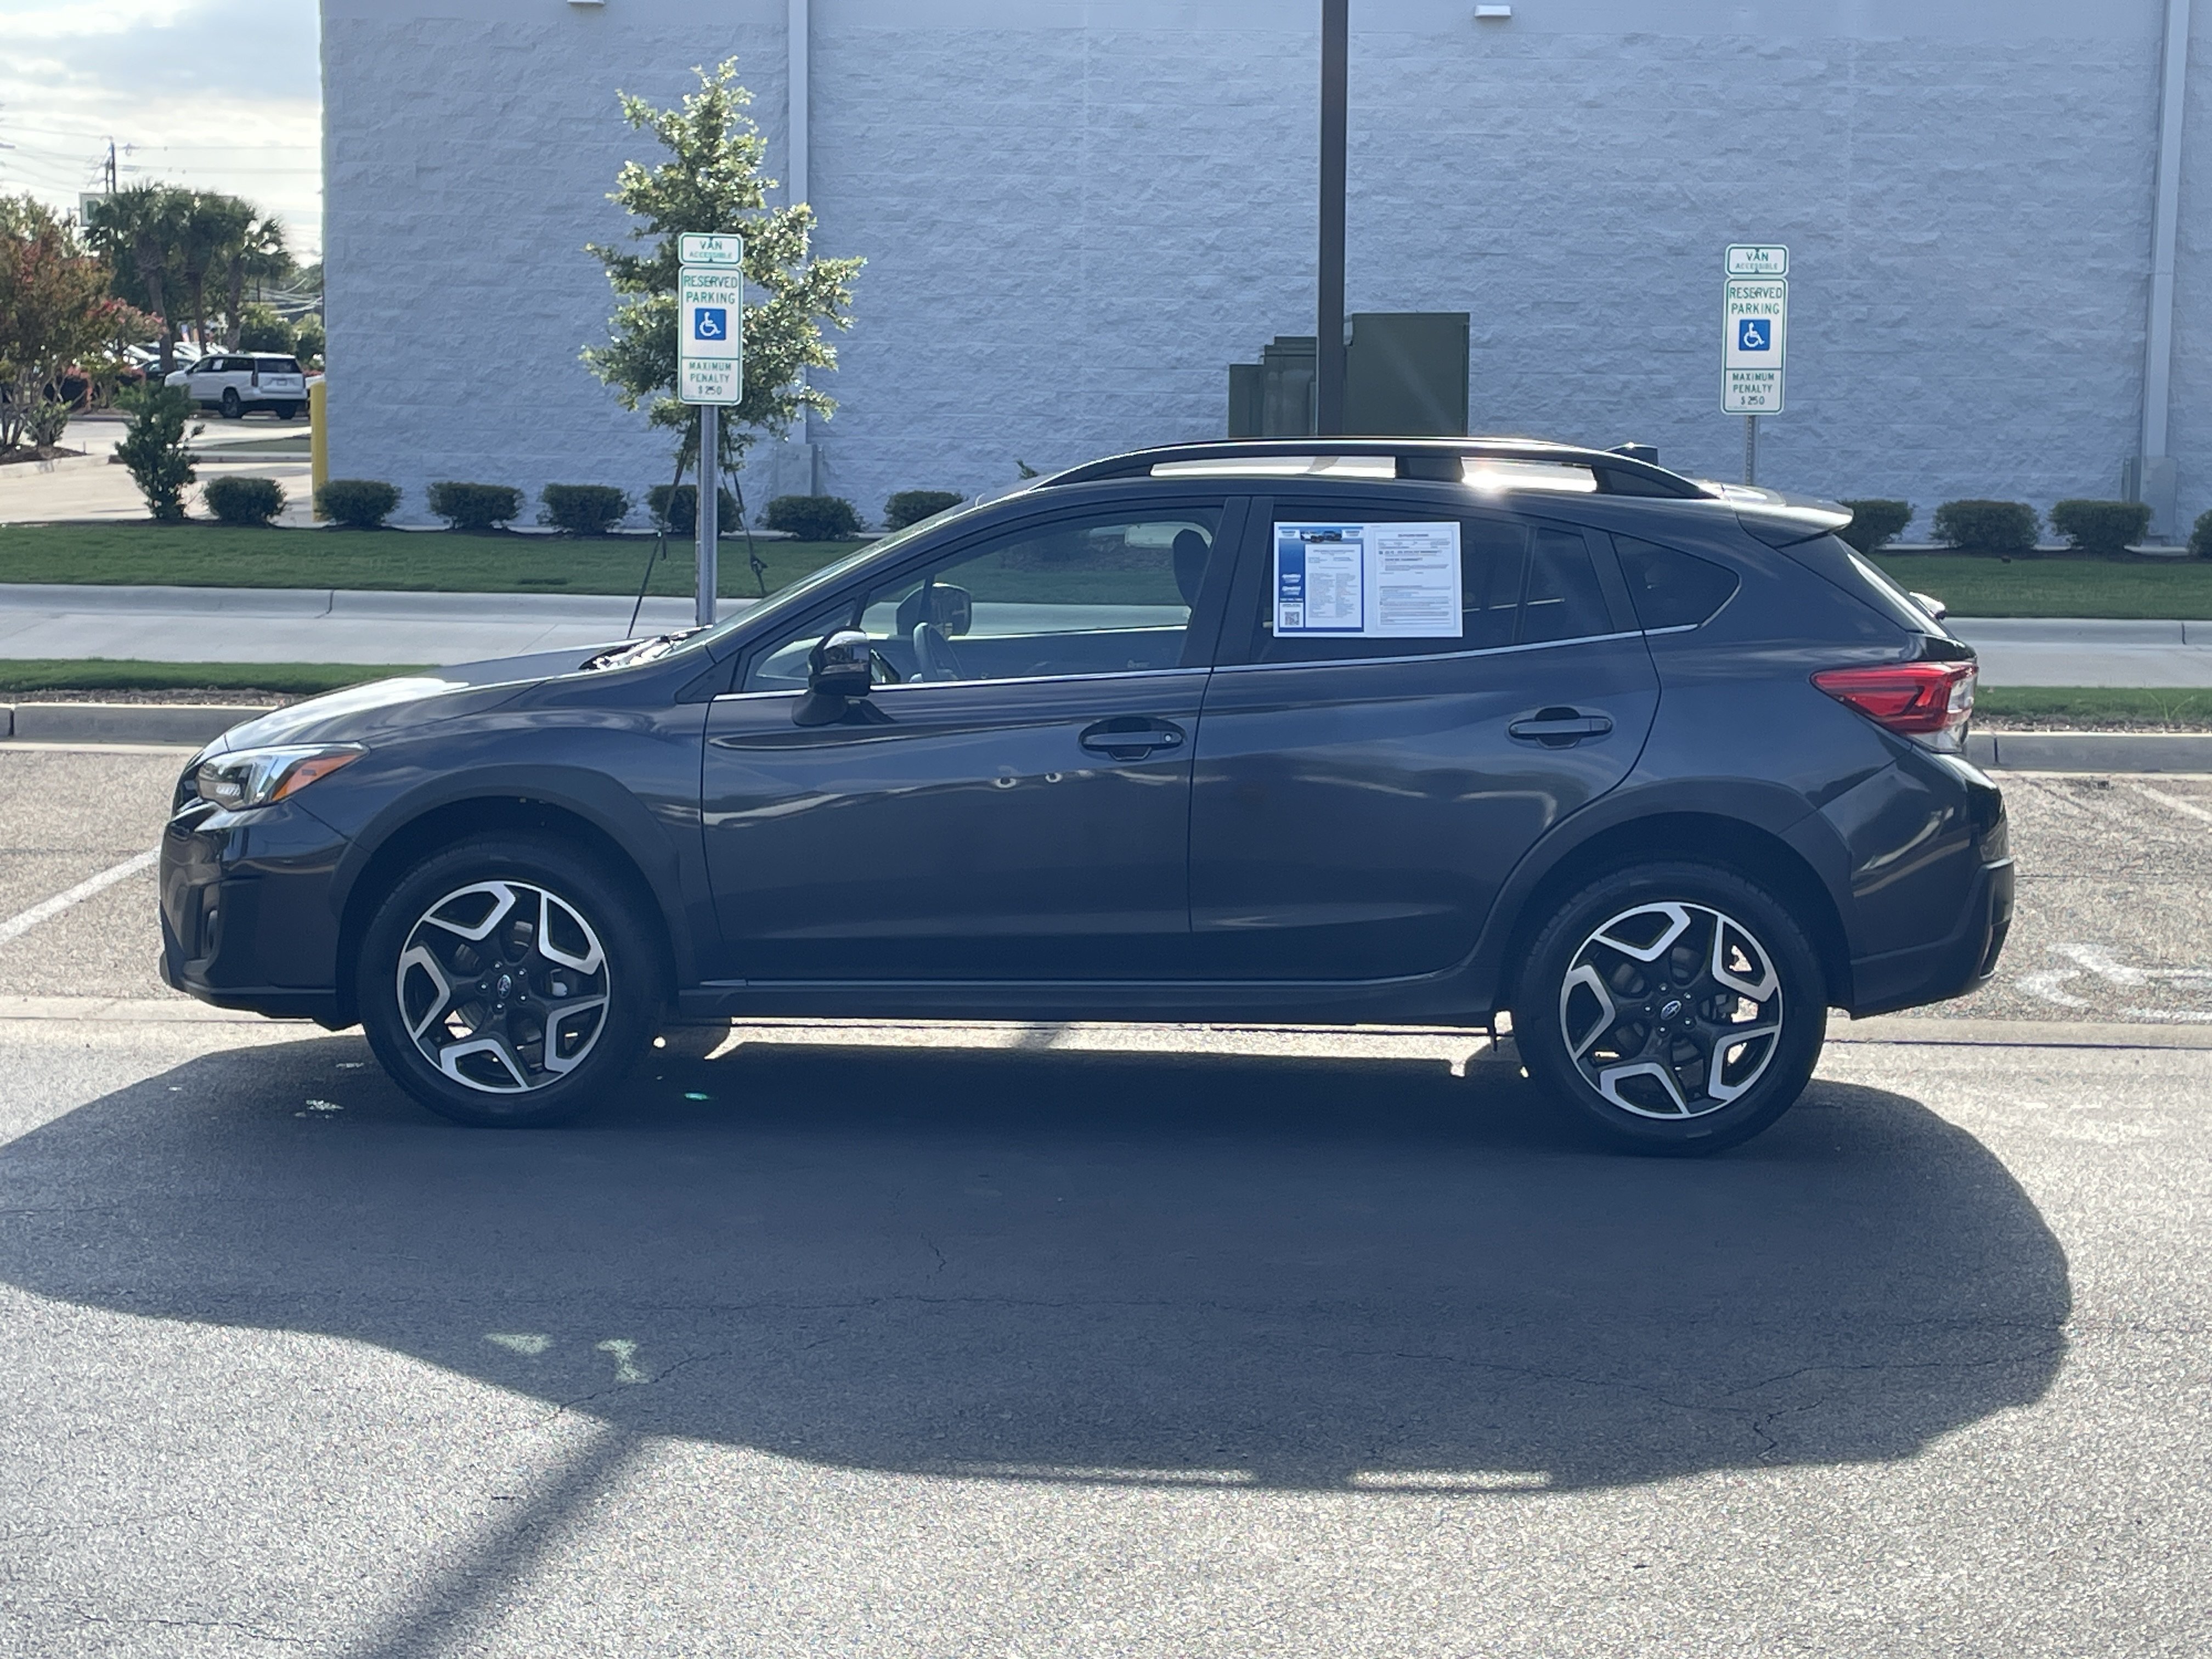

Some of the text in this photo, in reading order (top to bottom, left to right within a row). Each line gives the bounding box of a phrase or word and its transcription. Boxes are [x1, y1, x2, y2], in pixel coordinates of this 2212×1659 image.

[699, 241, 723, 250] VAN
[1746, 252, 1769, 261] VAN
[684, 275, 738, 288] RESERVED
[686, 291, 735, 304] PARKING
[1729, 287, 1782, 299] RESERVED
[1731, 302, 1780, 314] PARKING
[689, 362, 731, 371] MAXIMUM
[690, 373, 730, 383] PENALTY
[1732, 373, 1774, 381] MAXIMUM
[1733, 384, 1773, 393] PENALTY
